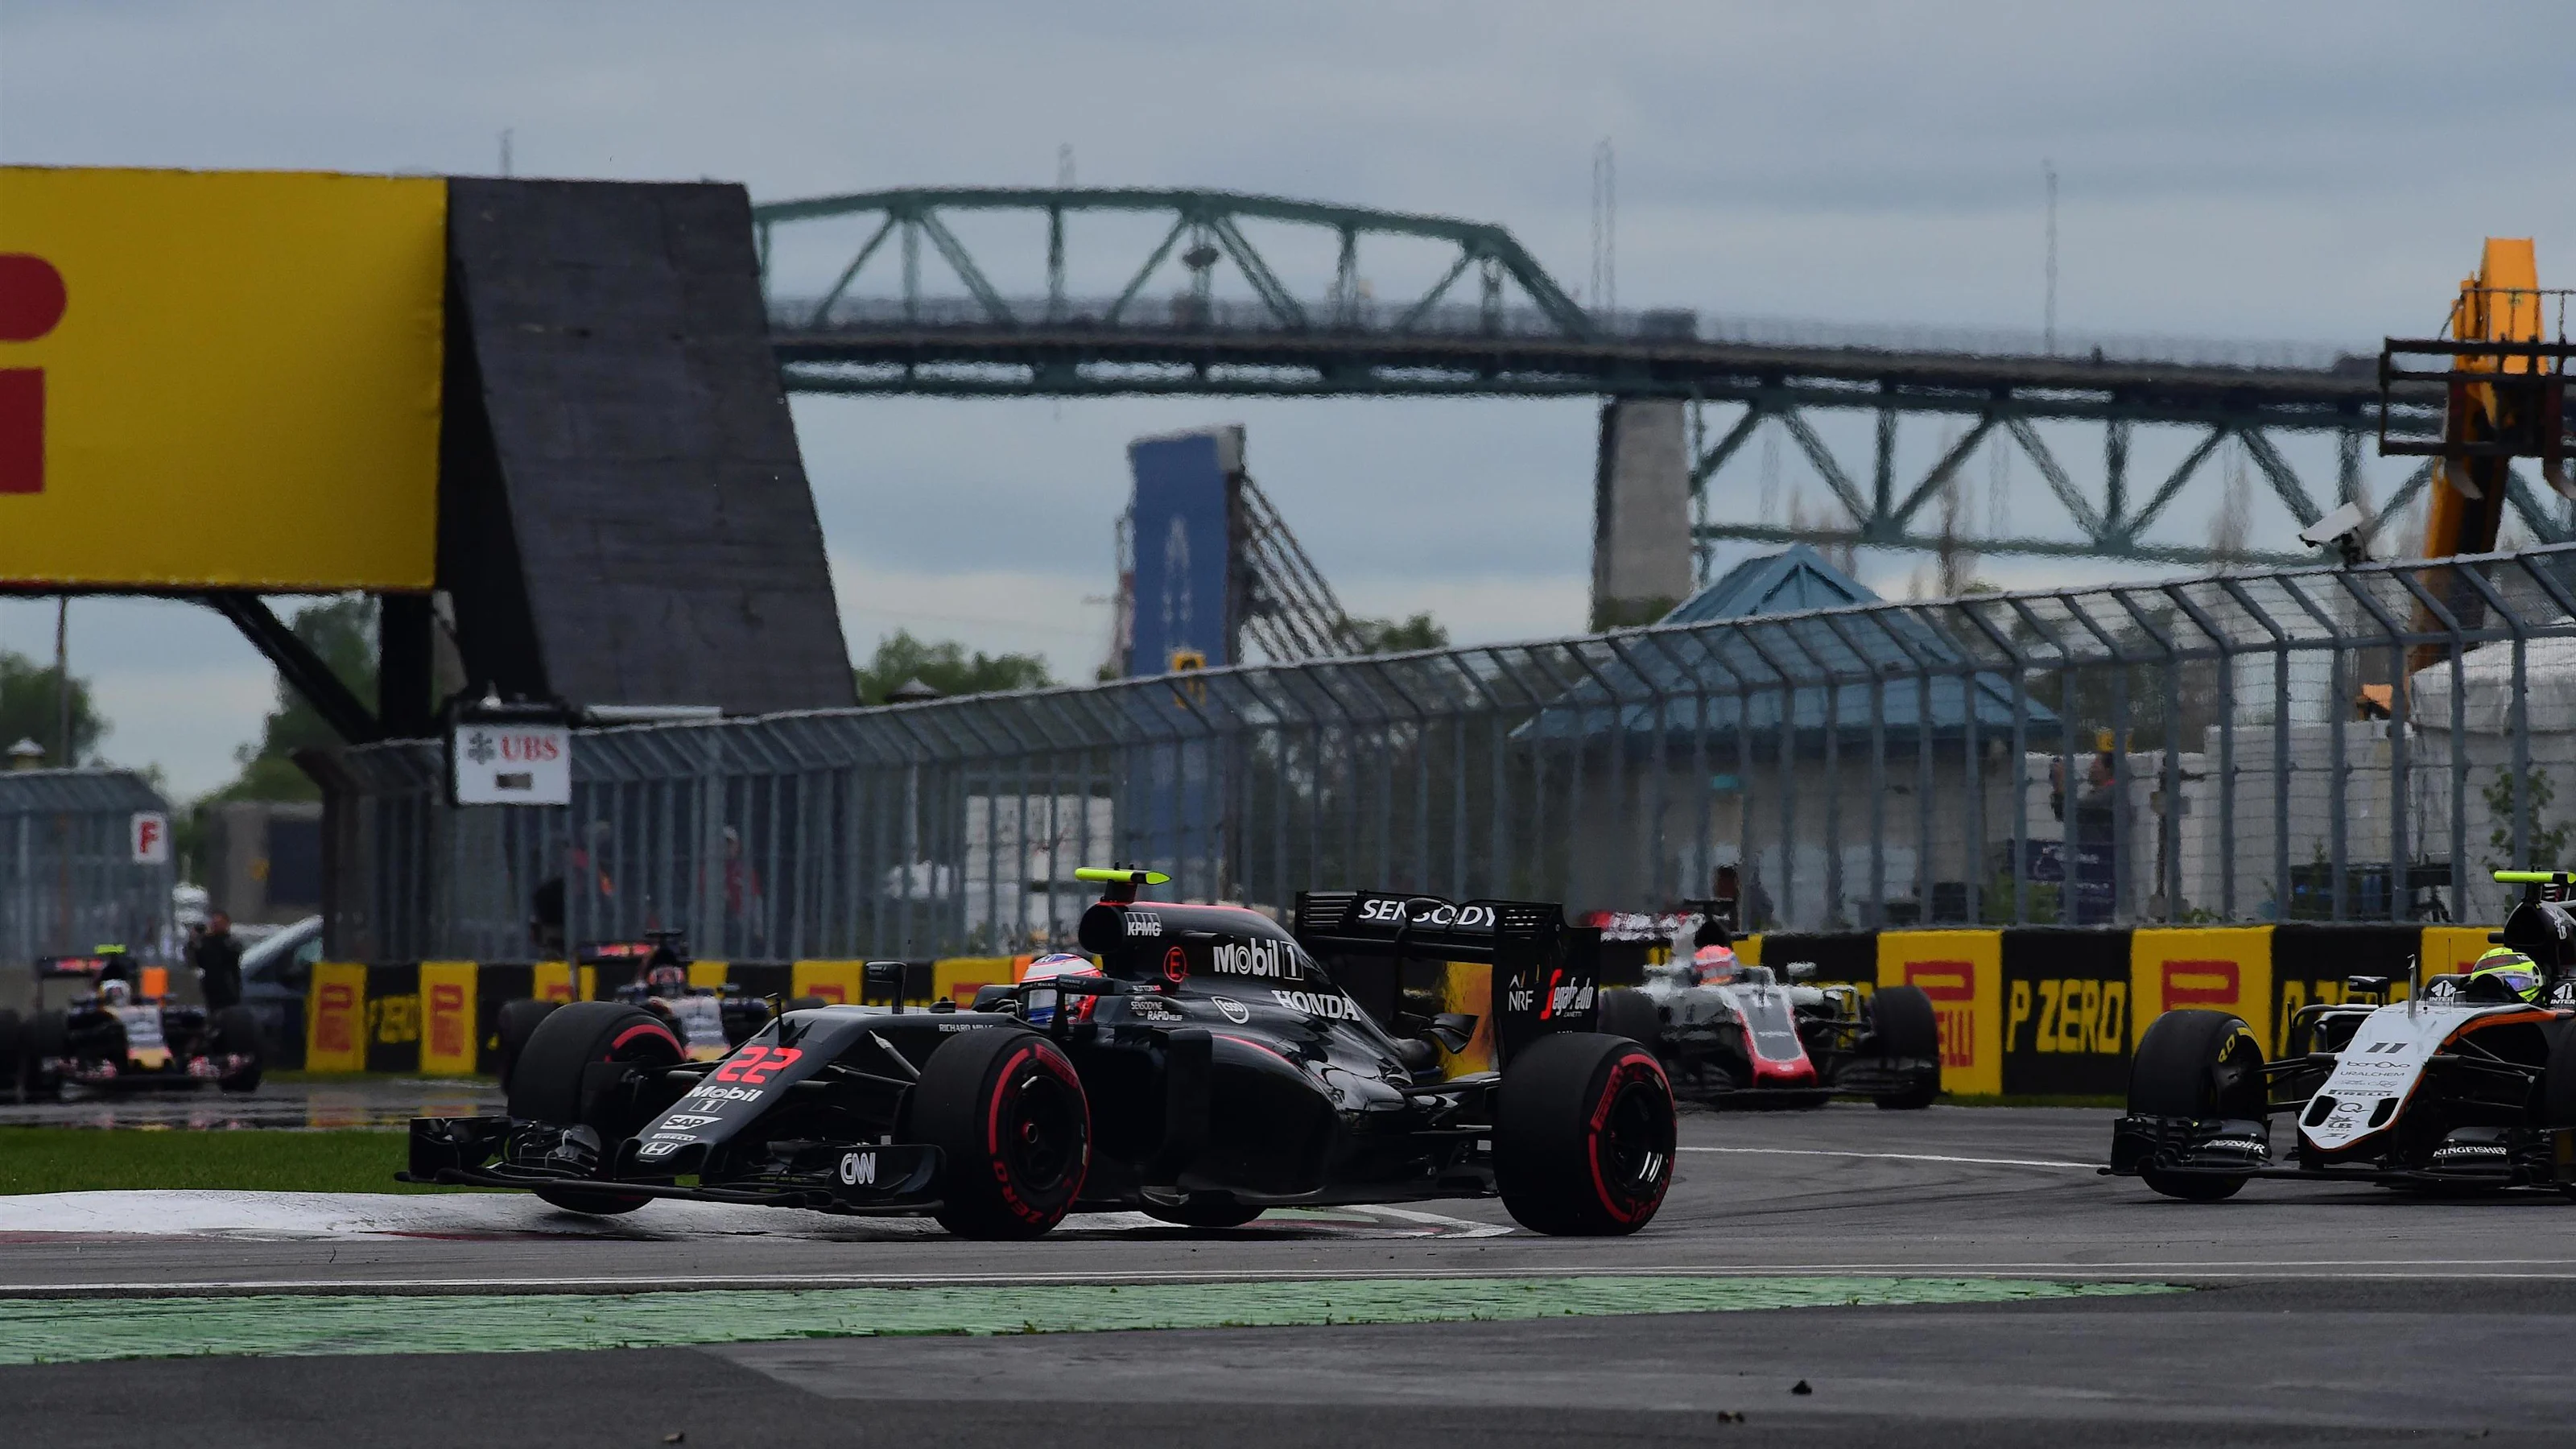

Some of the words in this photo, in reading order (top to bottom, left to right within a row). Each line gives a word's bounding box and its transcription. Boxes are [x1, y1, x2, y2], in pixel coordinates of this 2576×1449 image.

[500, 733, 560, 761] UBS
[139, 821, 159, 854] F
[1127, 921, 1163, 937] KPMG
[1213, 938, 1280, 977] Mobil
[1130, 1001, 1164, 1010] SENSODYNE
[1271, 990, 1361, 1022] HONDA
[1509, 990, 1534, 1012] NRF
[1147, 1010, 1170, 1020] RAPID
[2007, 980, 2033, 1053] P
[2036, 978, 2127, 1055] ZERO
[2365, 1042, 2409, 1054] 11
[715, 1046, 803, 1084] 22
[685, 1086, 764, 1103] Mobil
[665, 1117, 704, 1126] SAP
[840, 1152, 877, 1186] CNN
